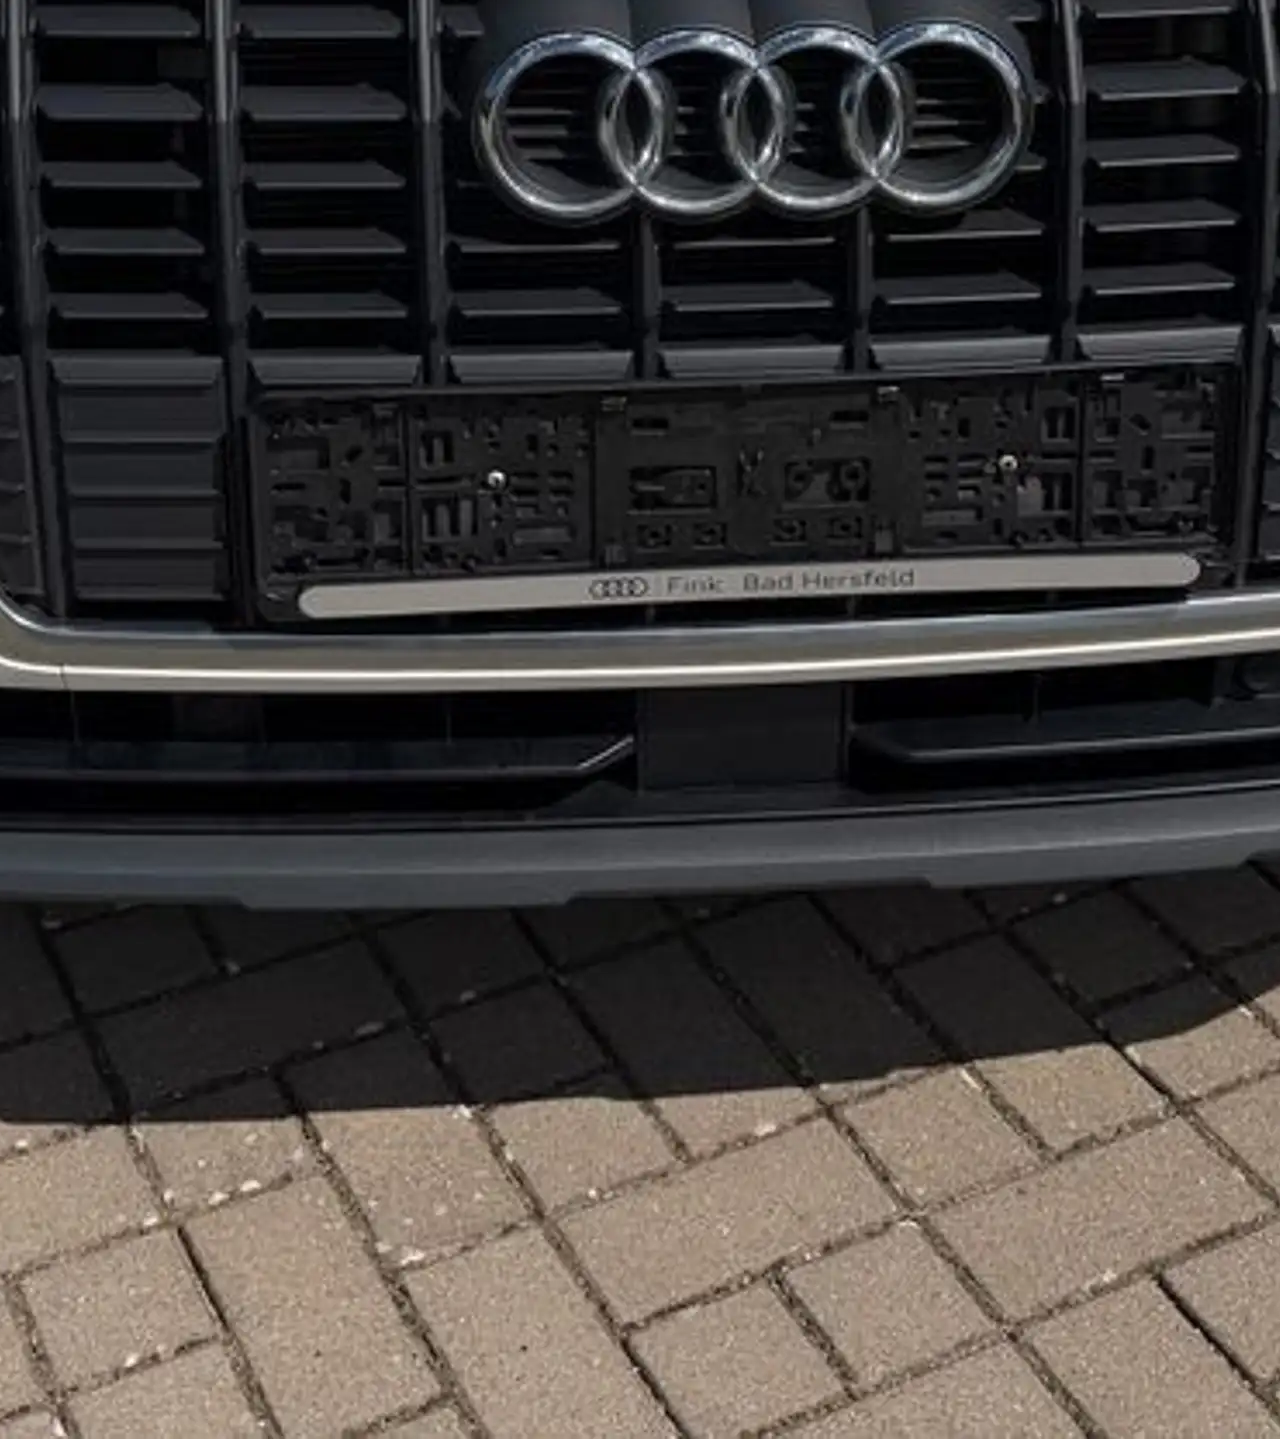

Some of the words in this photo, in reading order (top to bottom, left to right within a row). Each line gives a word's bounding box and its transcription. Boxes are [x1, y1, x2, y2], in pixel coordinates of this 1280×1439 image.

[667, 576, 724, 594] Fink
[743, 572, 794, 592] Bad
[802, 568, 915, 590] Hersfeld
